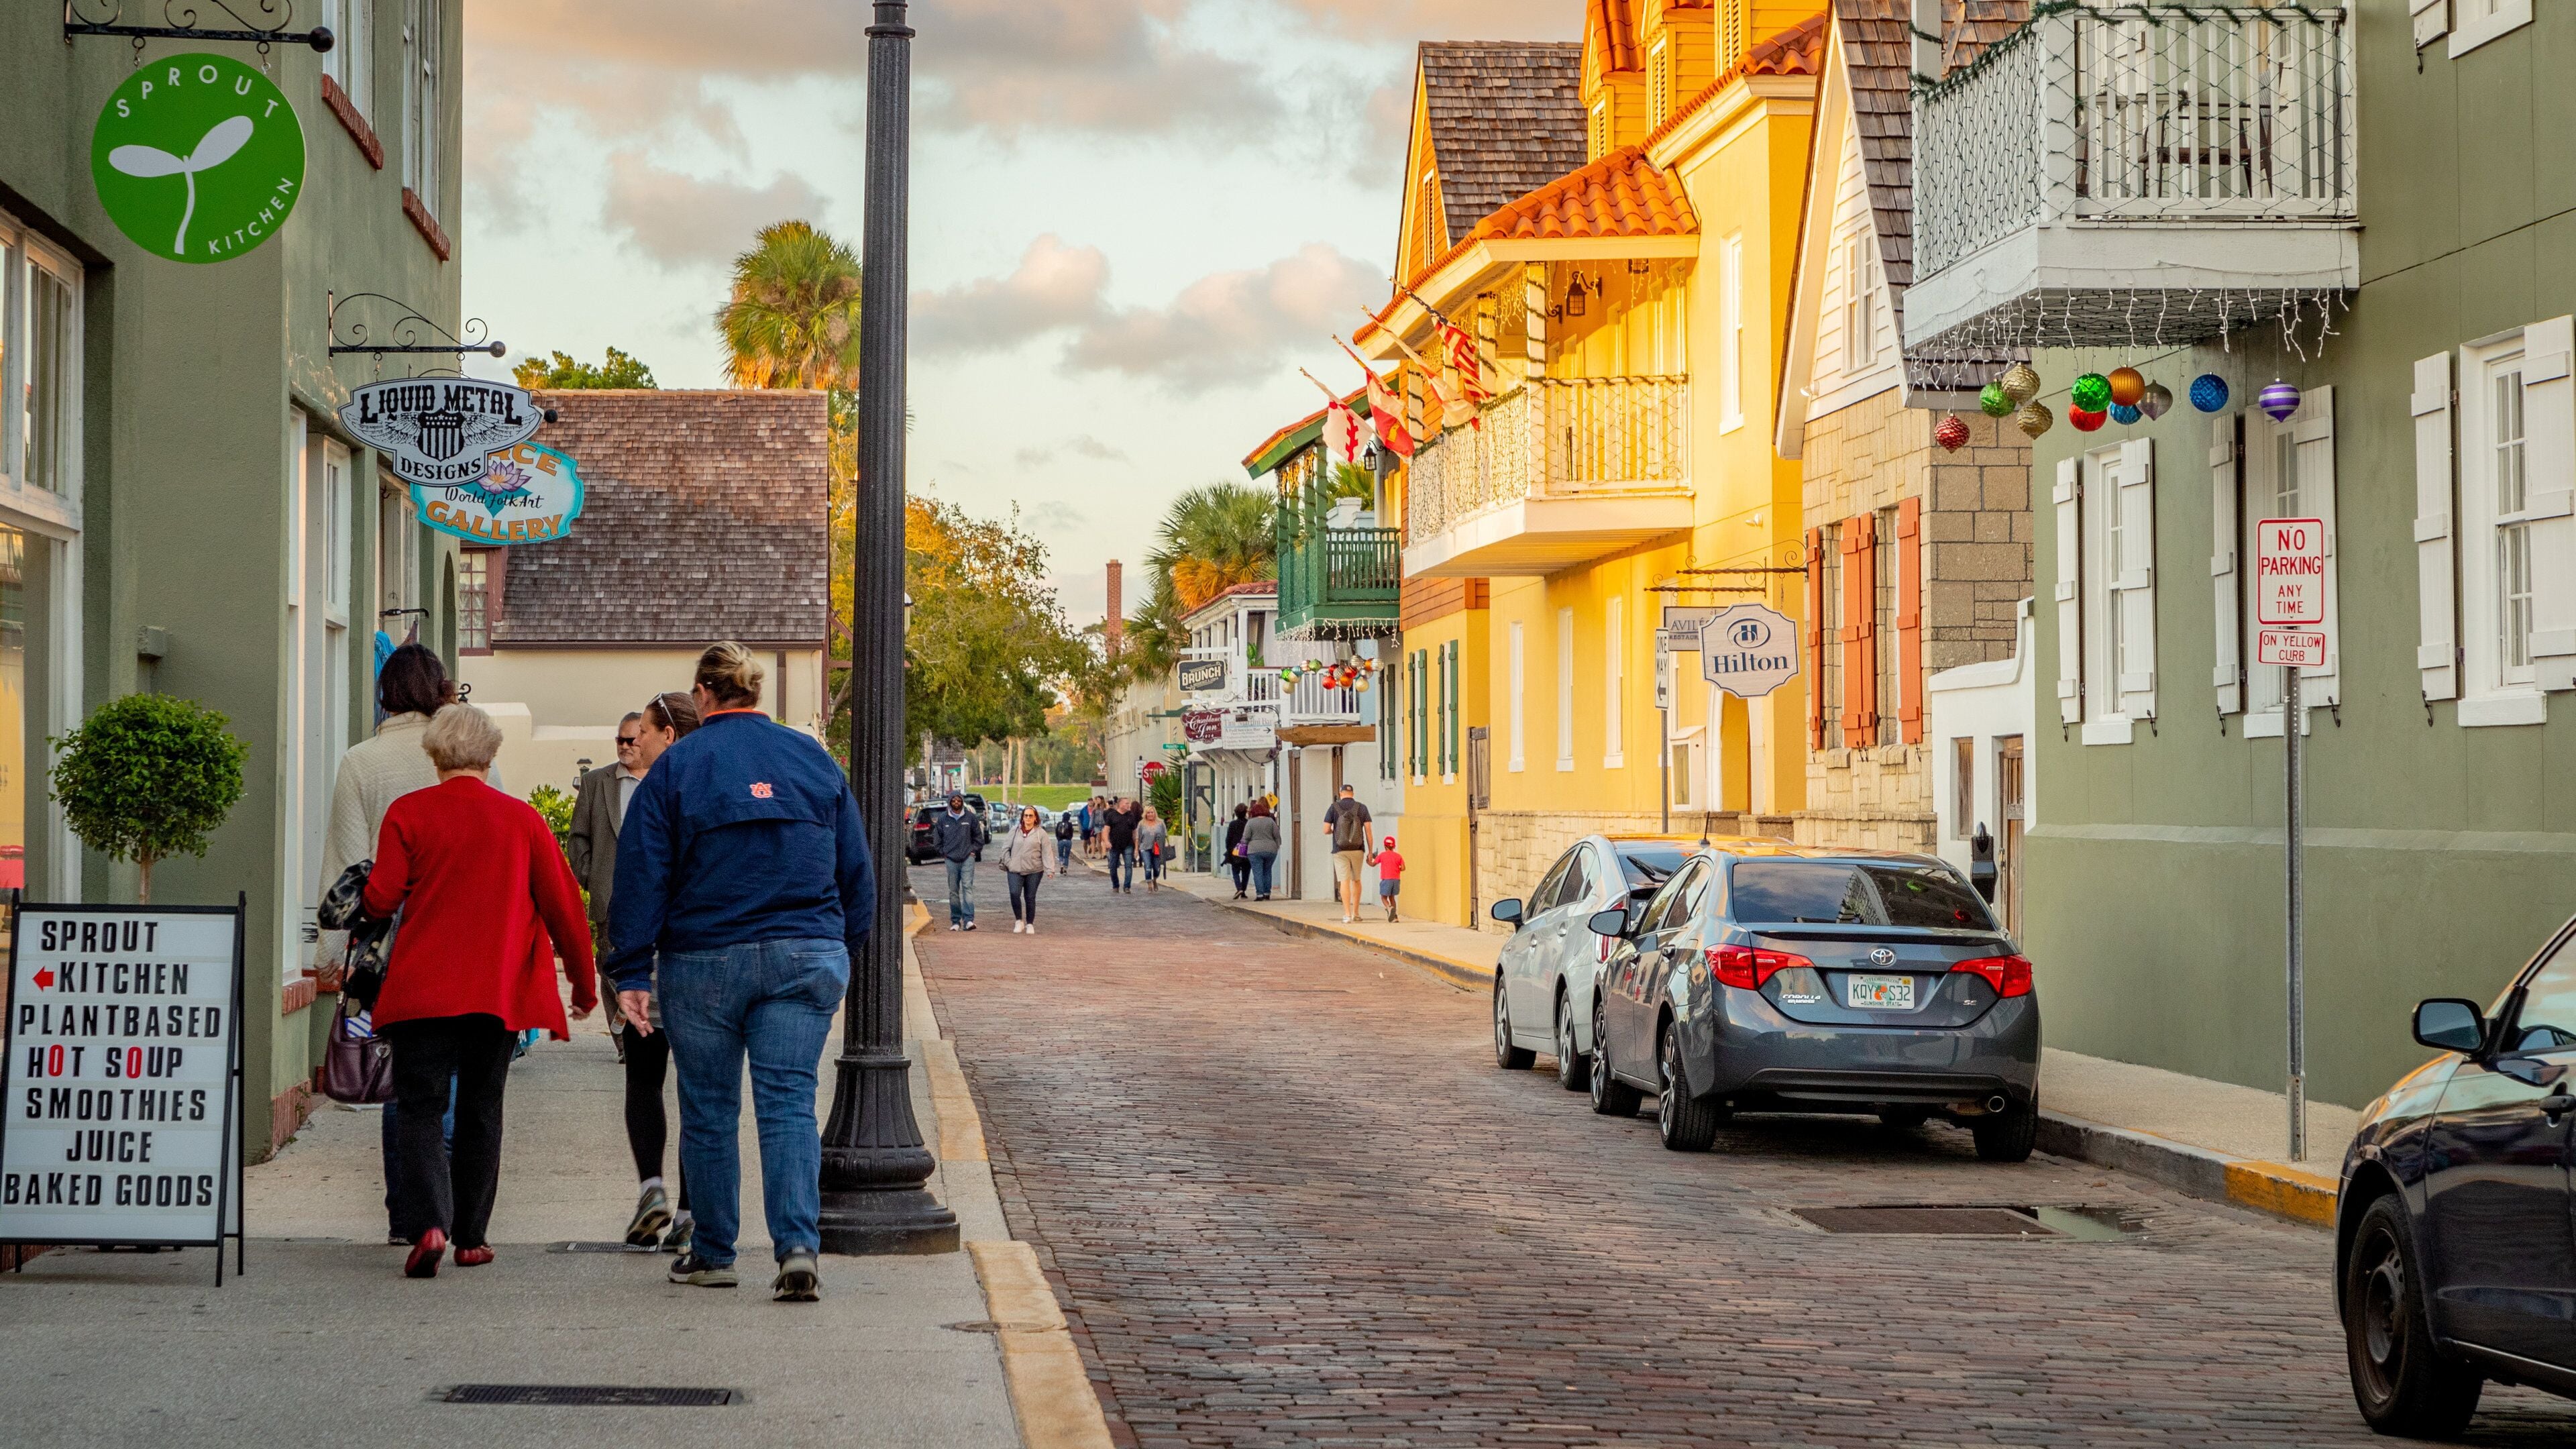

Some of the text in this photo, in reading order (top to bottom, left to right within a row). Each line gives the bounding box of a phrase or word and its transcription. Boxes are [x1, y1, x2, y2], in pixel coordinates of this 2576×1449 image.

[116, 65, 278, 117] SPROUT
[208, 177, 294, 254] KITCHEN
[360, 384, 522, 425] LIQUID METAL
[400, 457, 481, 480] DESIGNS
[445, 486, 544, 508] World Folk Art
[426, 500, 563, 541] GALLERY
[2278, 529, 2305, 551] NO
[2261, 556, 2321, 575] PARKING
[2278, 585, 2303, 597] ANY
[2276, 601, 2304, 613] TIME
[1656, 636, 1667, 653] ONE
[2263, 635, 2321, 647] ON YELLOW
[1713, 652, 1789, 674] Hilton
[2279, 650, 2305, 661] CURB
[1182, 666, 1221, 686] BRUNCH
[1656, 659, 1668, 676] WAY
[40, 920, 158, 953] SPROUT
[59, 961, 189, 995] KITCHEN
[1889, 985, 1910, 1001] S32
[18, 1004, 221, 1038] PLANTBASED
[27, 1044, 182, 1079] HOT SOUP
[25, 1087, 206, 1122] SMOOTHIES
[66, 1130, 152, 1163] JUICE
[4, 1173, 212, 1207] BAKED GOODS
